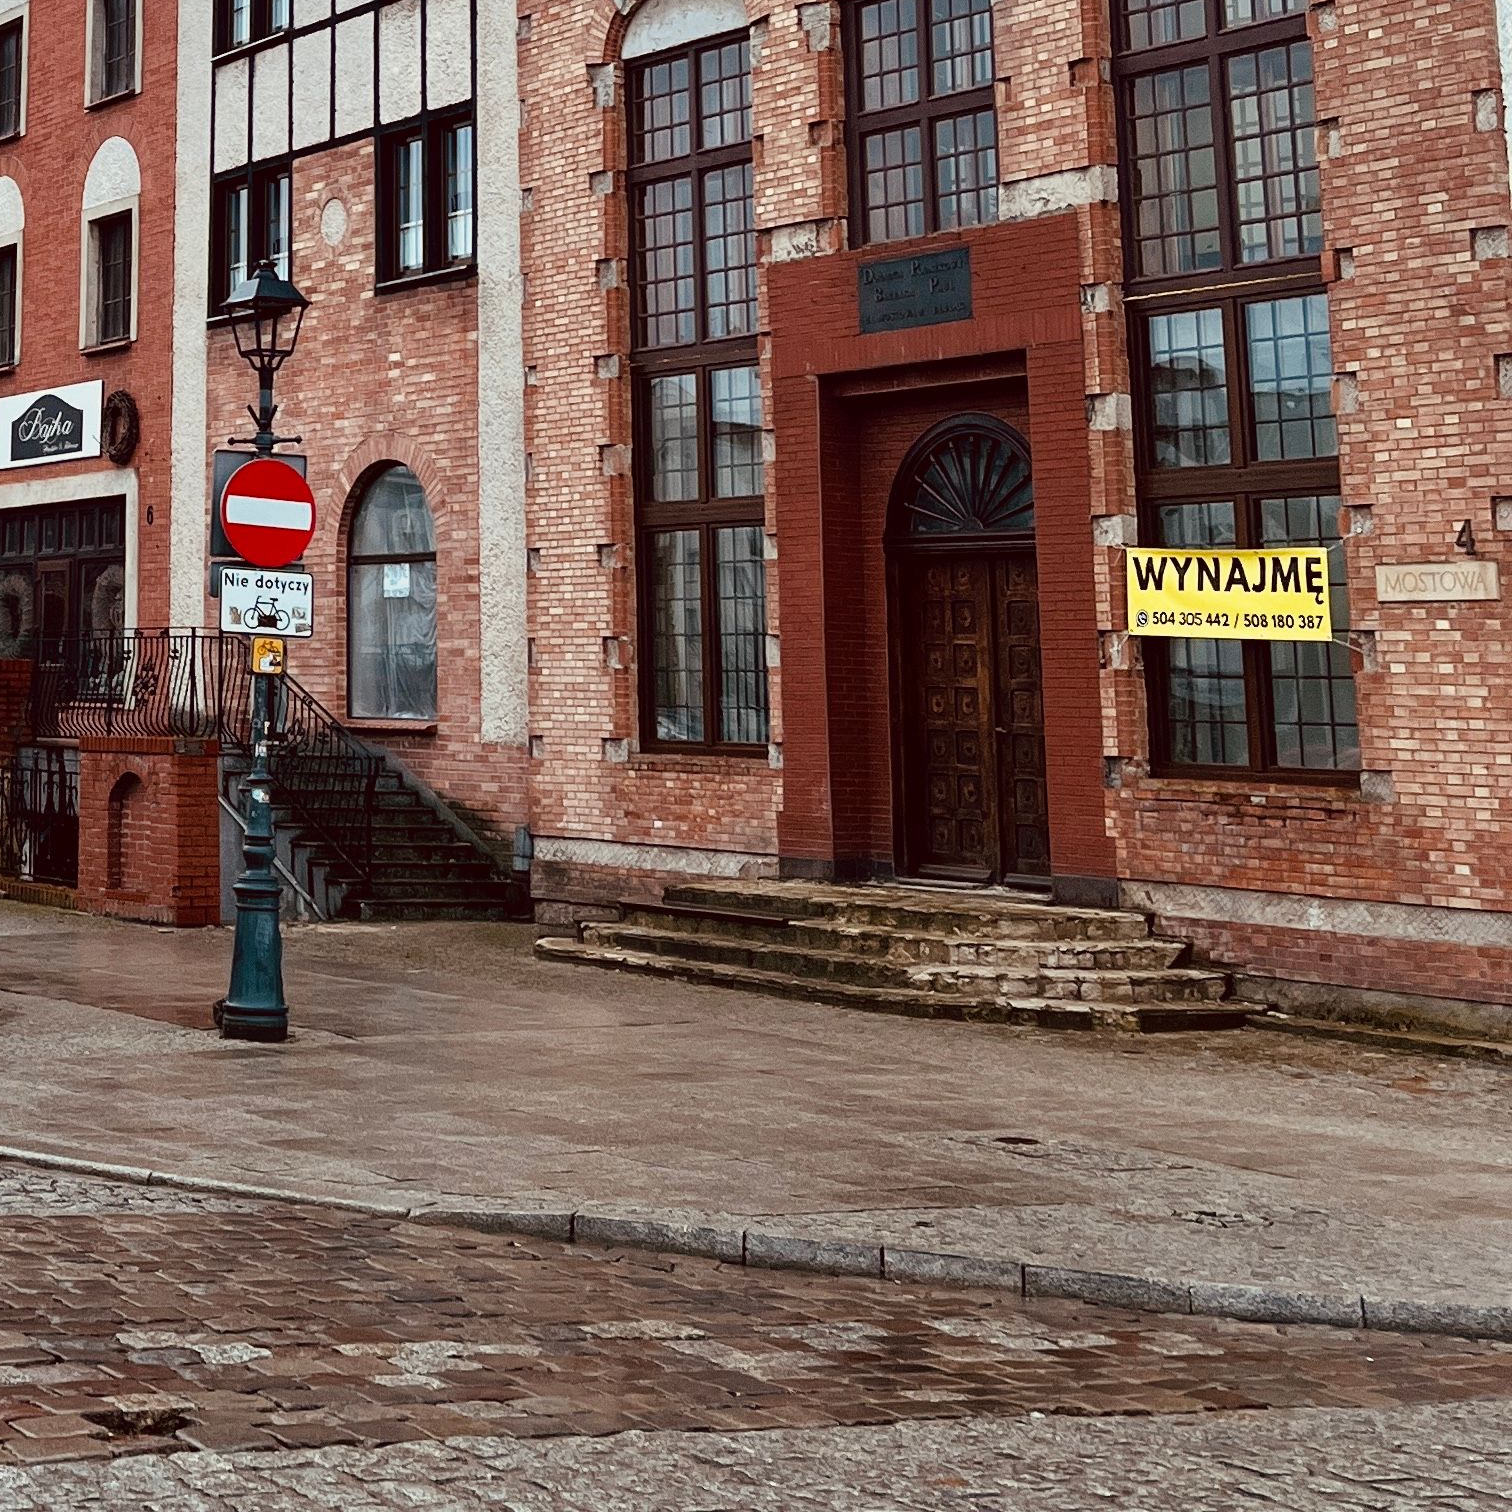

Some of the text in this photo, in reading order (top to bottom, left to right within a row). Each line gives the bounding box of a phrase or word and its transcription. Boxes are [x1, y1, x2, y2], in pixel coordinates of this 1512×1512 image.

[18, 407, 75, 444] Bajka
[146, 505, 154, 525] 6
[1455, 519, 1478, 555] 4
[224, 572, 310, 595] Nie dotyczy
[1132, 556, 1325, 605] WYNAJMĘ
[1383, 570, 1489, 594] MOSTOWA
[1152, 611, 1175, 625] 504
[1179, 612, 1202, 626] 305
[1205, 612, 1229, 627] 442
[1244, 613, 1268, 628] 508
[1273, 614, 1294, 629] 180
[1298, 614, 1324, 629] 387
